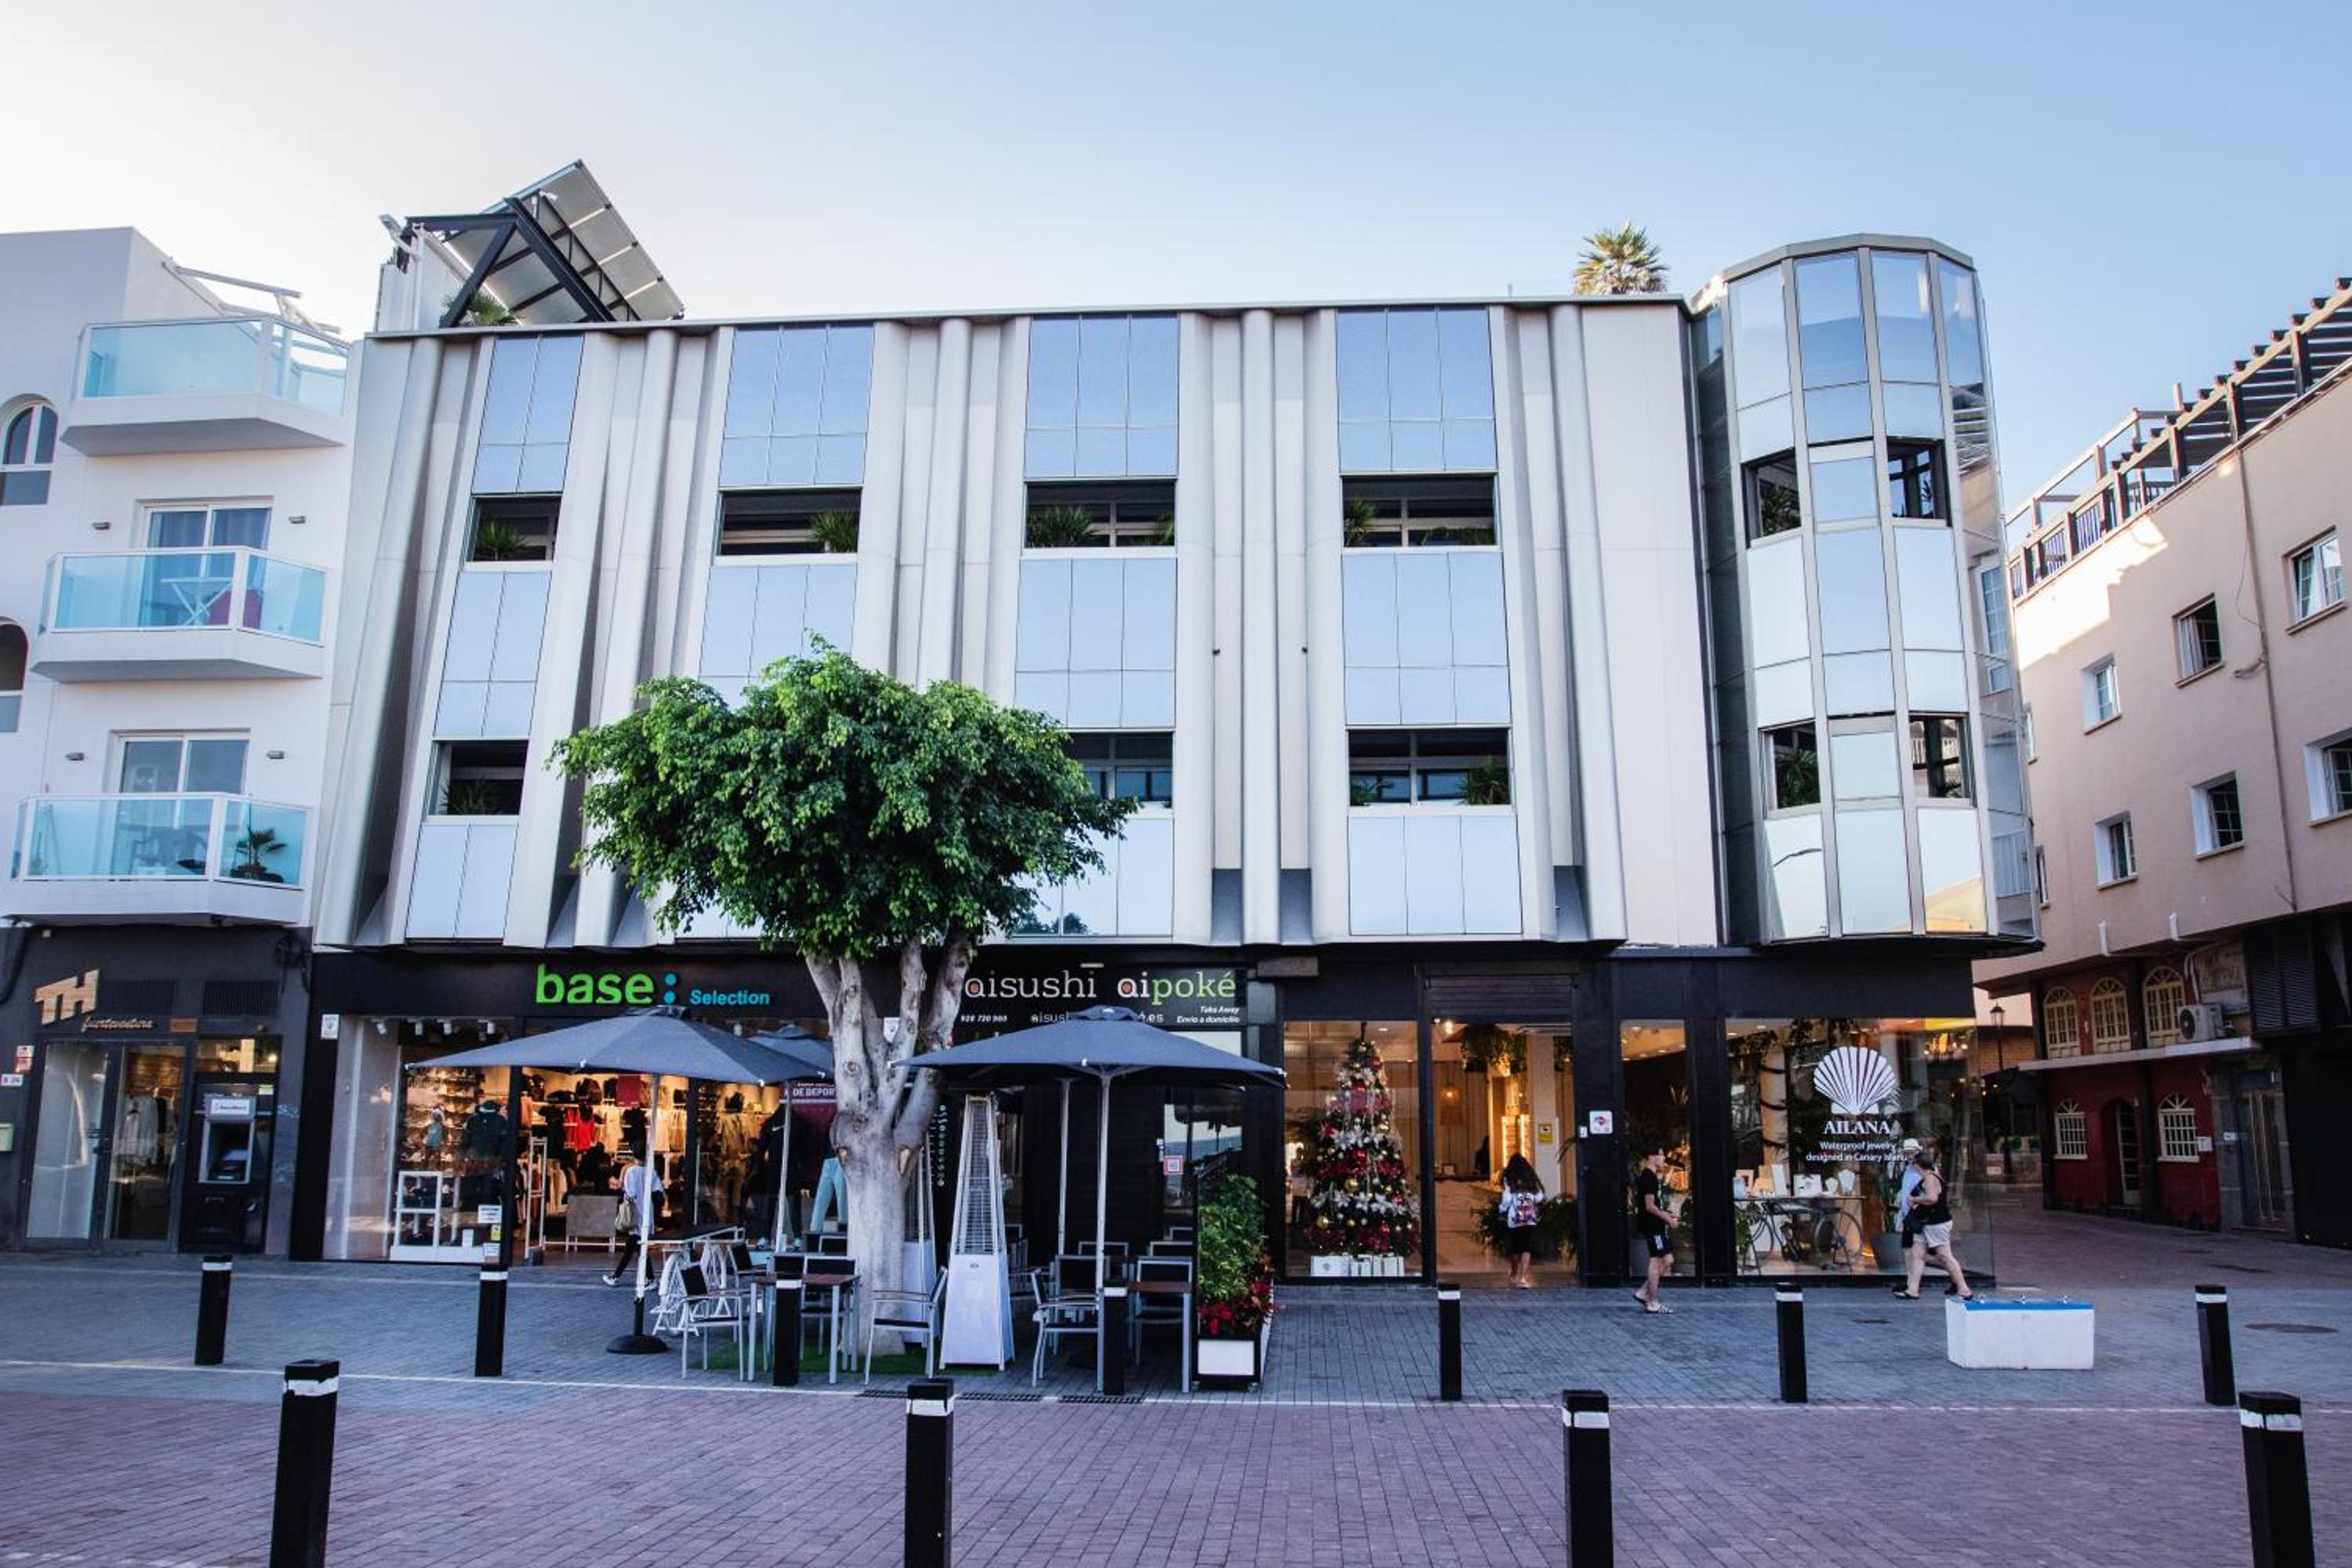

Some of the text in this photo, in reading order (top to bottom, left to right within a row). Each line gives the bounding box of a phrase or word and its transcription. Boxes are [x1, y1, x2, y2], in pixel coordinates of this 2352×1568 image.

[1117, 971, 1236, 1005] aipoké
[34, 968, 100, 1025] TH
[690, 989, 771, 1005] Selection
[1823, 1120, 1891, 1134] AILANA
[1820, 1142, 1896, 1151] Waterproof jewelry
[1806, 1152, 1842, 1163] designed
[1854, 1152, 1882, 1162] Canary
